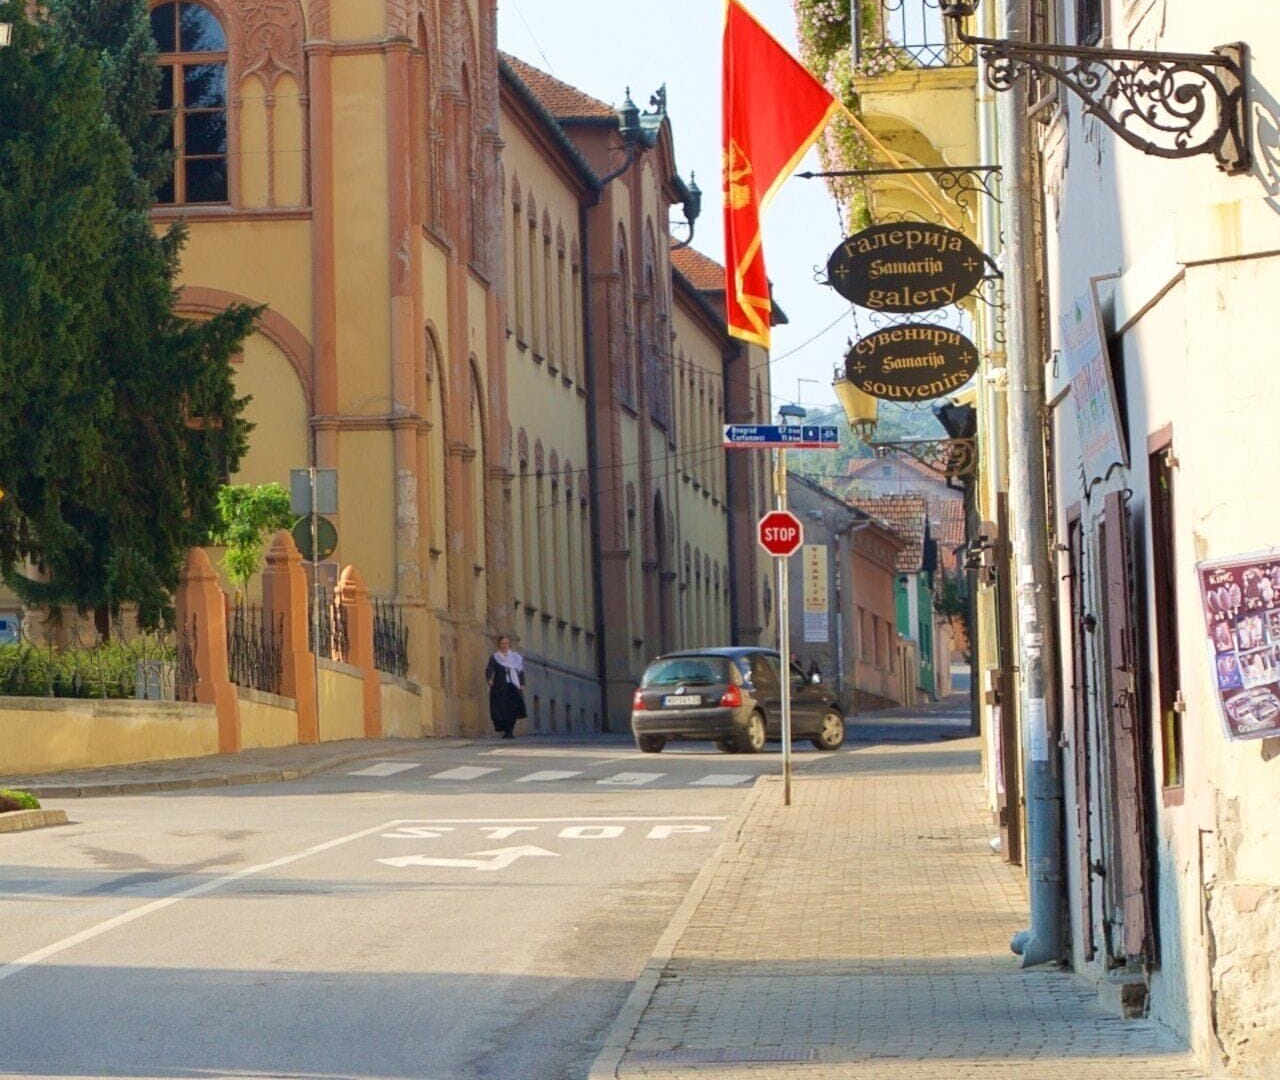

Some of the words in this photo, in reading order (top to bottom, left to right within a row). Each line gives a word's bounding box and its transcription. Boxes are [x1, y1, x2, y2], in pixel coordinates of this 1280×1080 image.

[844, 229, 963, 257] галерија
[869, 257, 944, 279] Samarija
[866, 283, 956, 308] galery
[855, 328, 961, 355] сувенири
[881, 352, 945, 373] Samarija
[863, 368, 970, 397] souvenirs
[764, 527, 796, 541] STOP
[1209, 572, 1233, 585] KING
[381, 825, 712, 839] STOP
